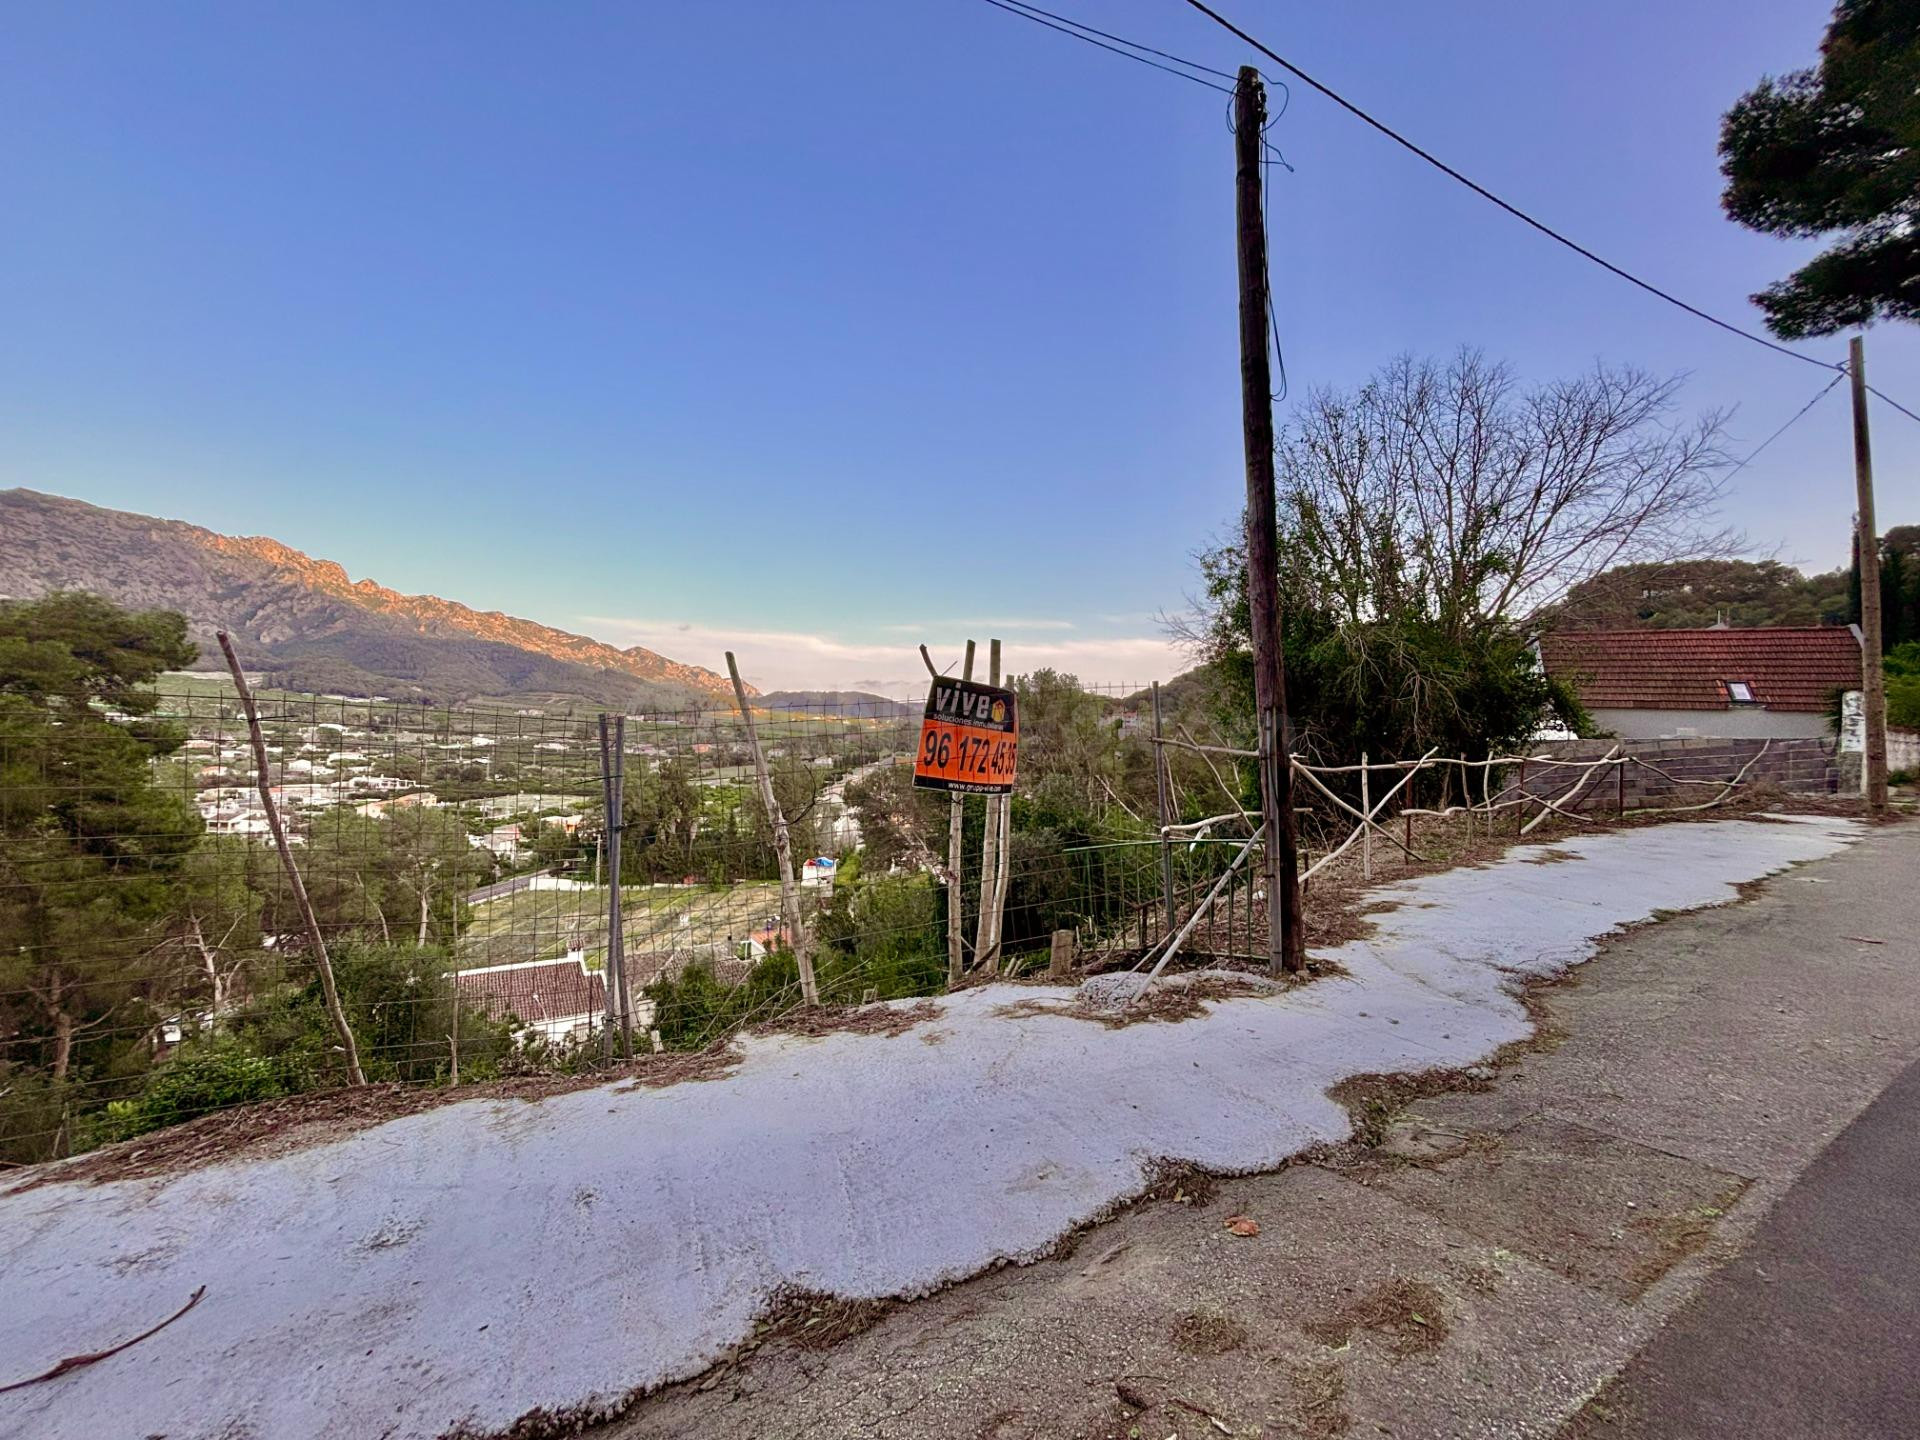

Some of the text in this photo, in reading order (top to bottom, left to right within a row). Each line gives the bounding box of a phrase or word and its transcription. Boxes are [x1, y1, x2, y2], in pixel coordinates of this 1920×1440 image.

[933, 713, 972, 725] soluciones
[936, 682, 991, 719] vive
[923, 730, 952, 768] 96
[959, 735, 990, 773] 172
